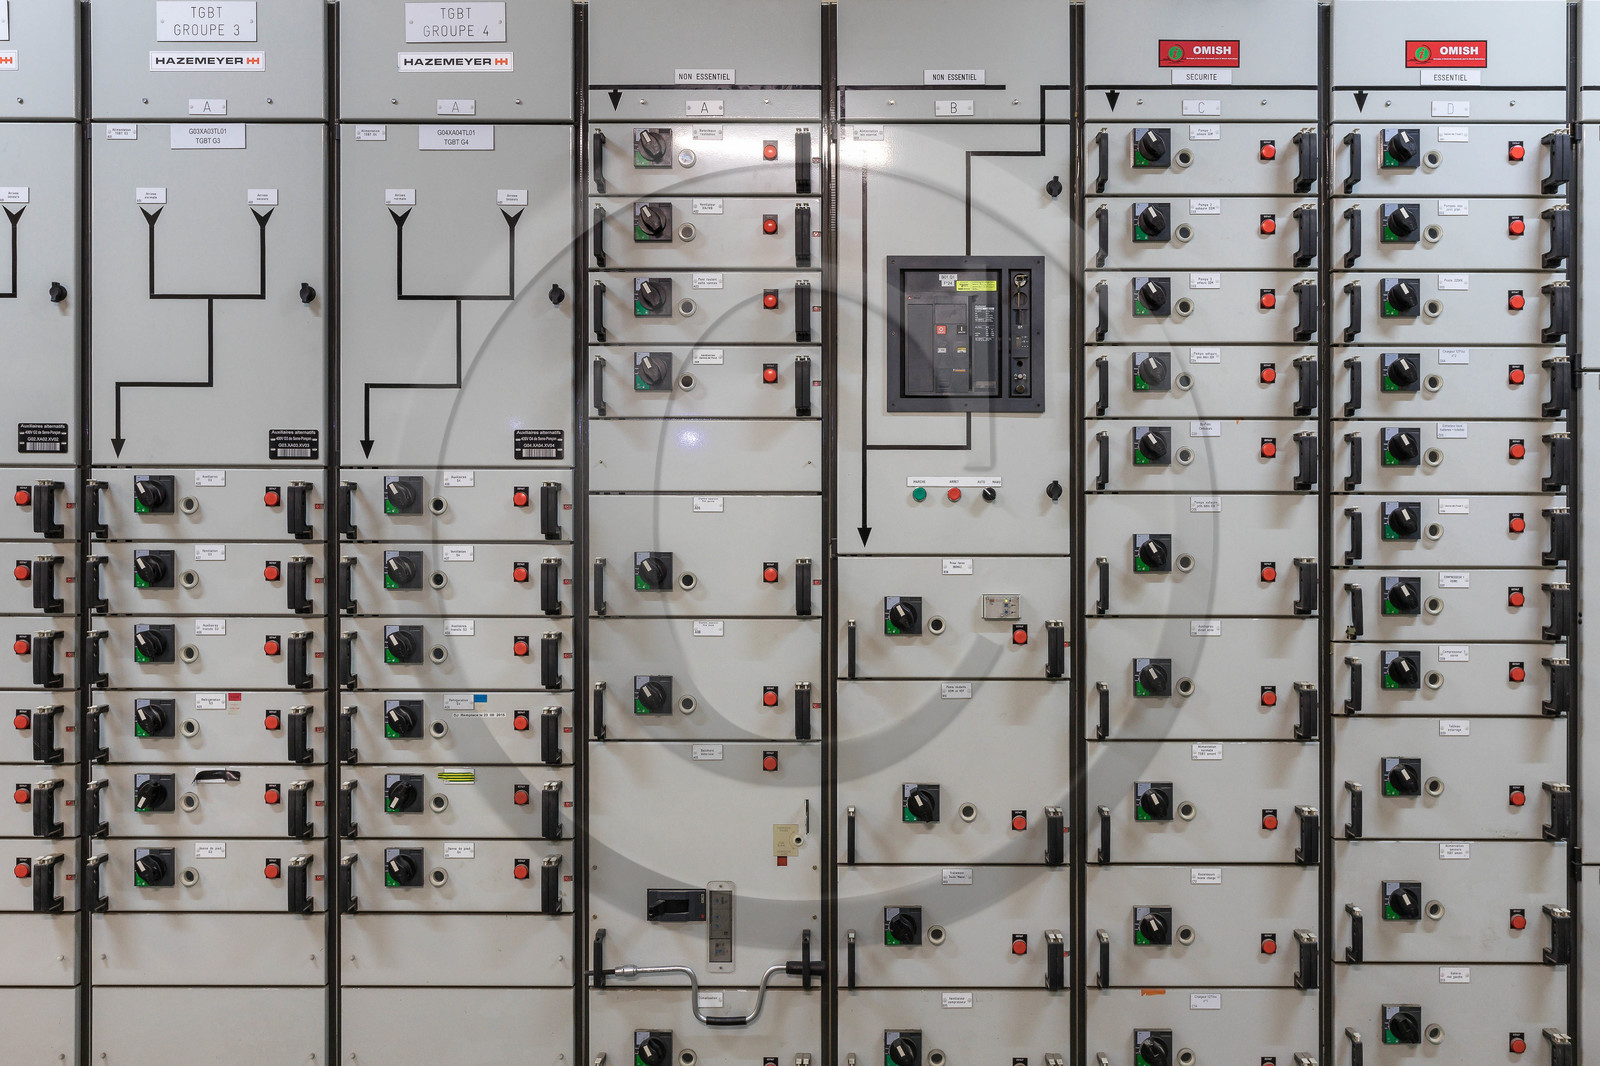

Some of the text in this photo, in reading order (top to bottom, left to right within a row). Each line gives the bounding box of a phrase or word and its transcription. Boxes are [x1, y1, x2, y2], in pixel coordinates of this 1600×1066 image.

[191, 6, 222, 19] TGBT
[440, 7, 472, 20] TGBT
[173, 24, 240, 36] GROUPE 3
[423, 25, 489, 37] GROUPE 4
[1193, 46, 1232, 55] OMISH
[1439, 46, 1479, 55] OMISH
[155, 57, 244, 65] HAZEMEYER
[403, 58, 492, 66] HAZEMEYER
[678, 73, 730, 81] NON ESSENTIEL
[932, 73, 977, 81] NON ESSENTIEL
[1186, 73, 1217, 81] SECURITE
[1433, 74, 1468, 82] ESSENTIEL
[203, 101, 211, 112] A
[452, 101, 460, 112] A
[700, 102, 709, 113] A
[950, 102, 957, 113] B
[1198, 101, 1205, 114] C
[1447, 102, 1454, 115] D
